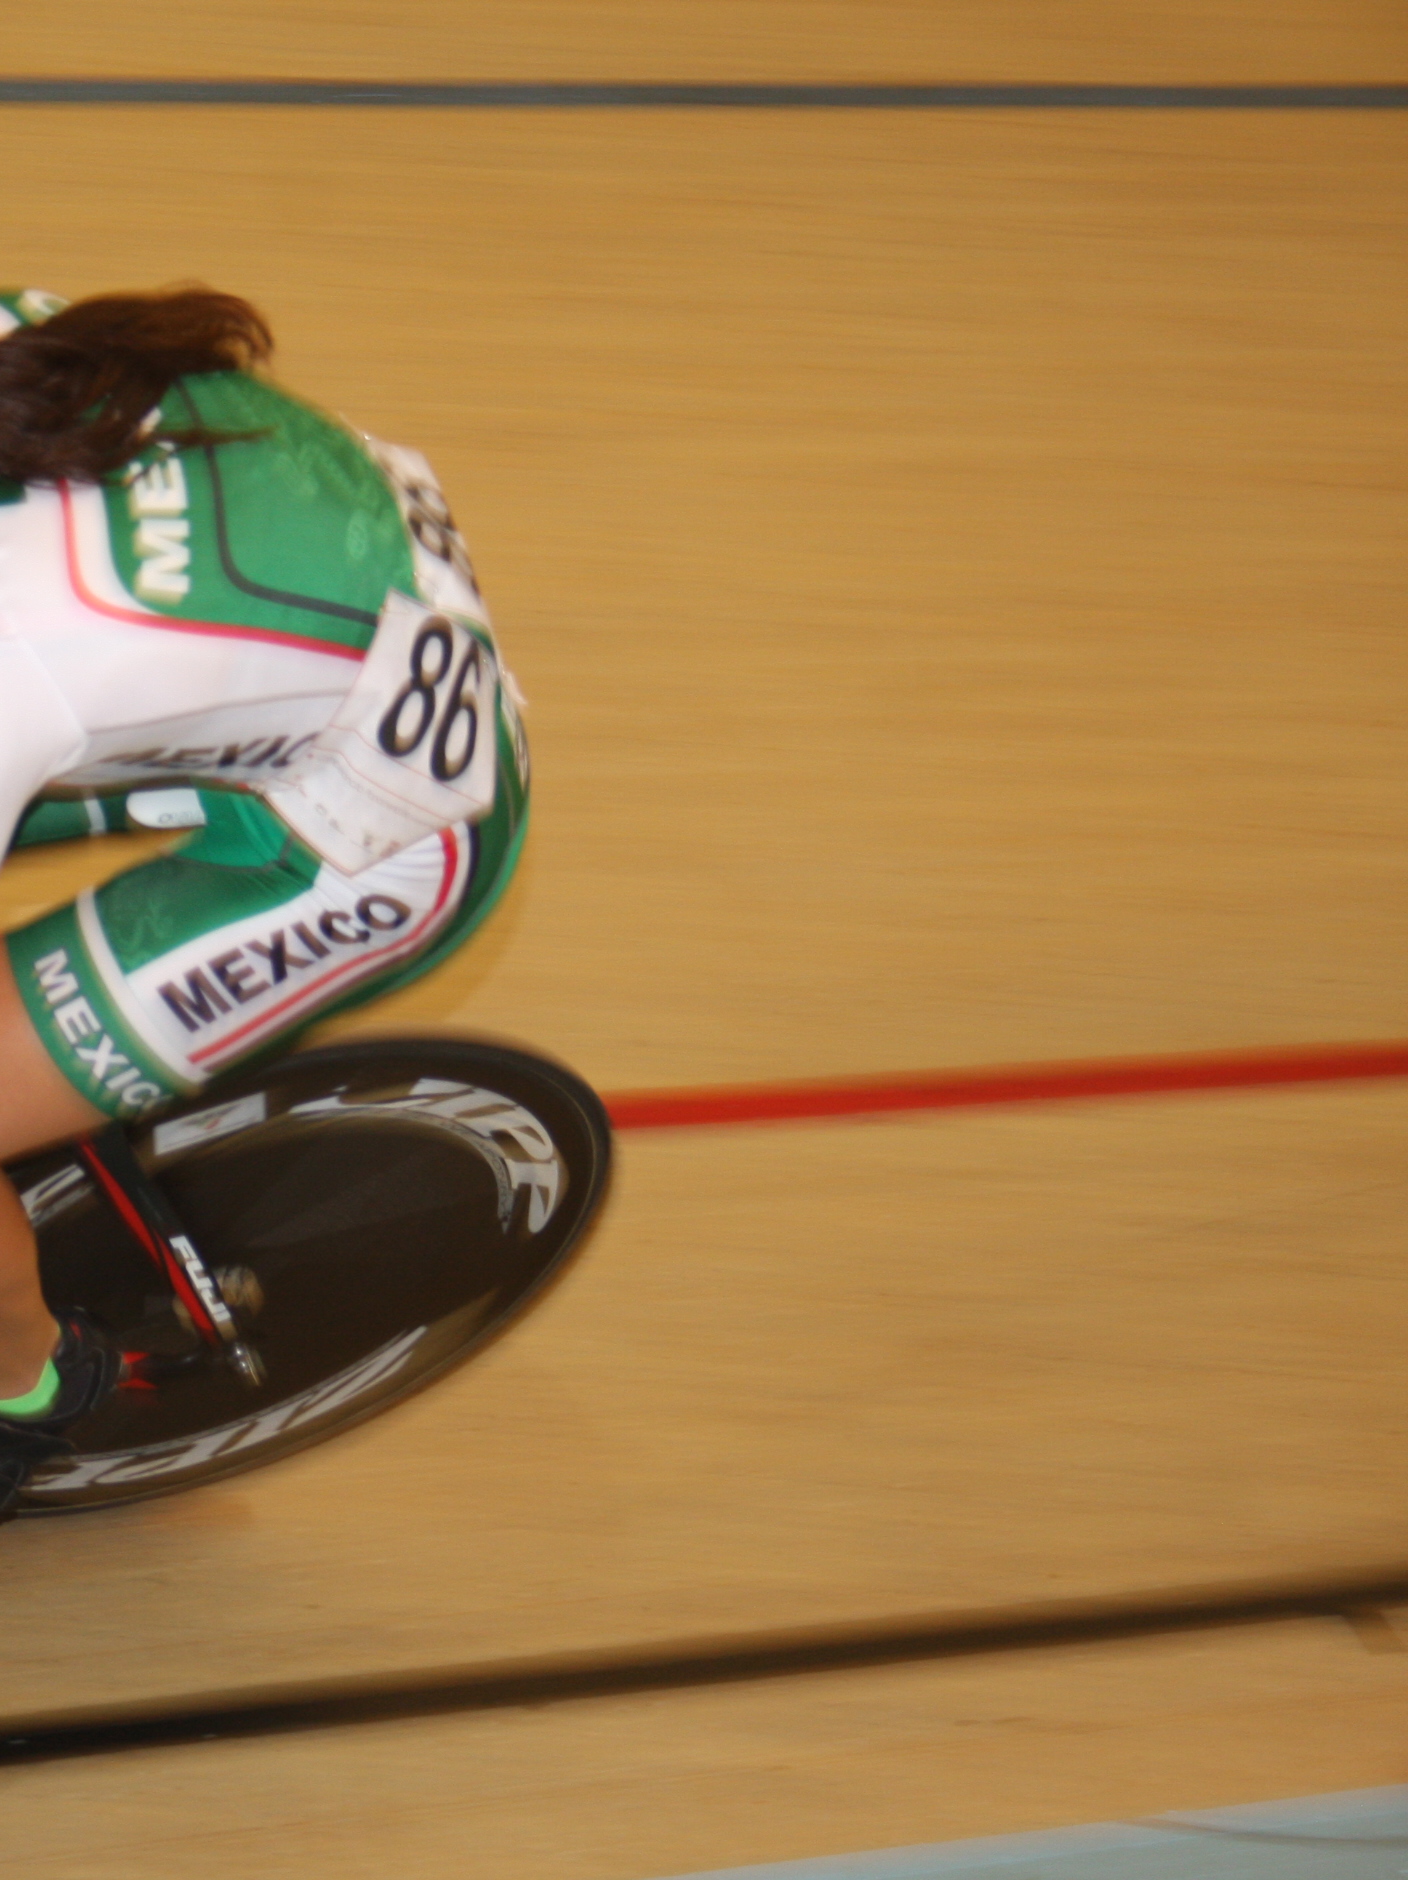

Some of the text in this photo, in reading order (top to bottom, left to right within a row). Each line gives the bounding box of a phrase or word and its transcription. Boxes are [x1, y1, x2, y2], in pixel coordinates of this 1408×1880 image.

[132, 438, 189, 603] ME
[378, 615, 480, 782] 86
[157, 894, 412, 1033] MEXICO
[168, 1235, 231, 1323] FUJI
